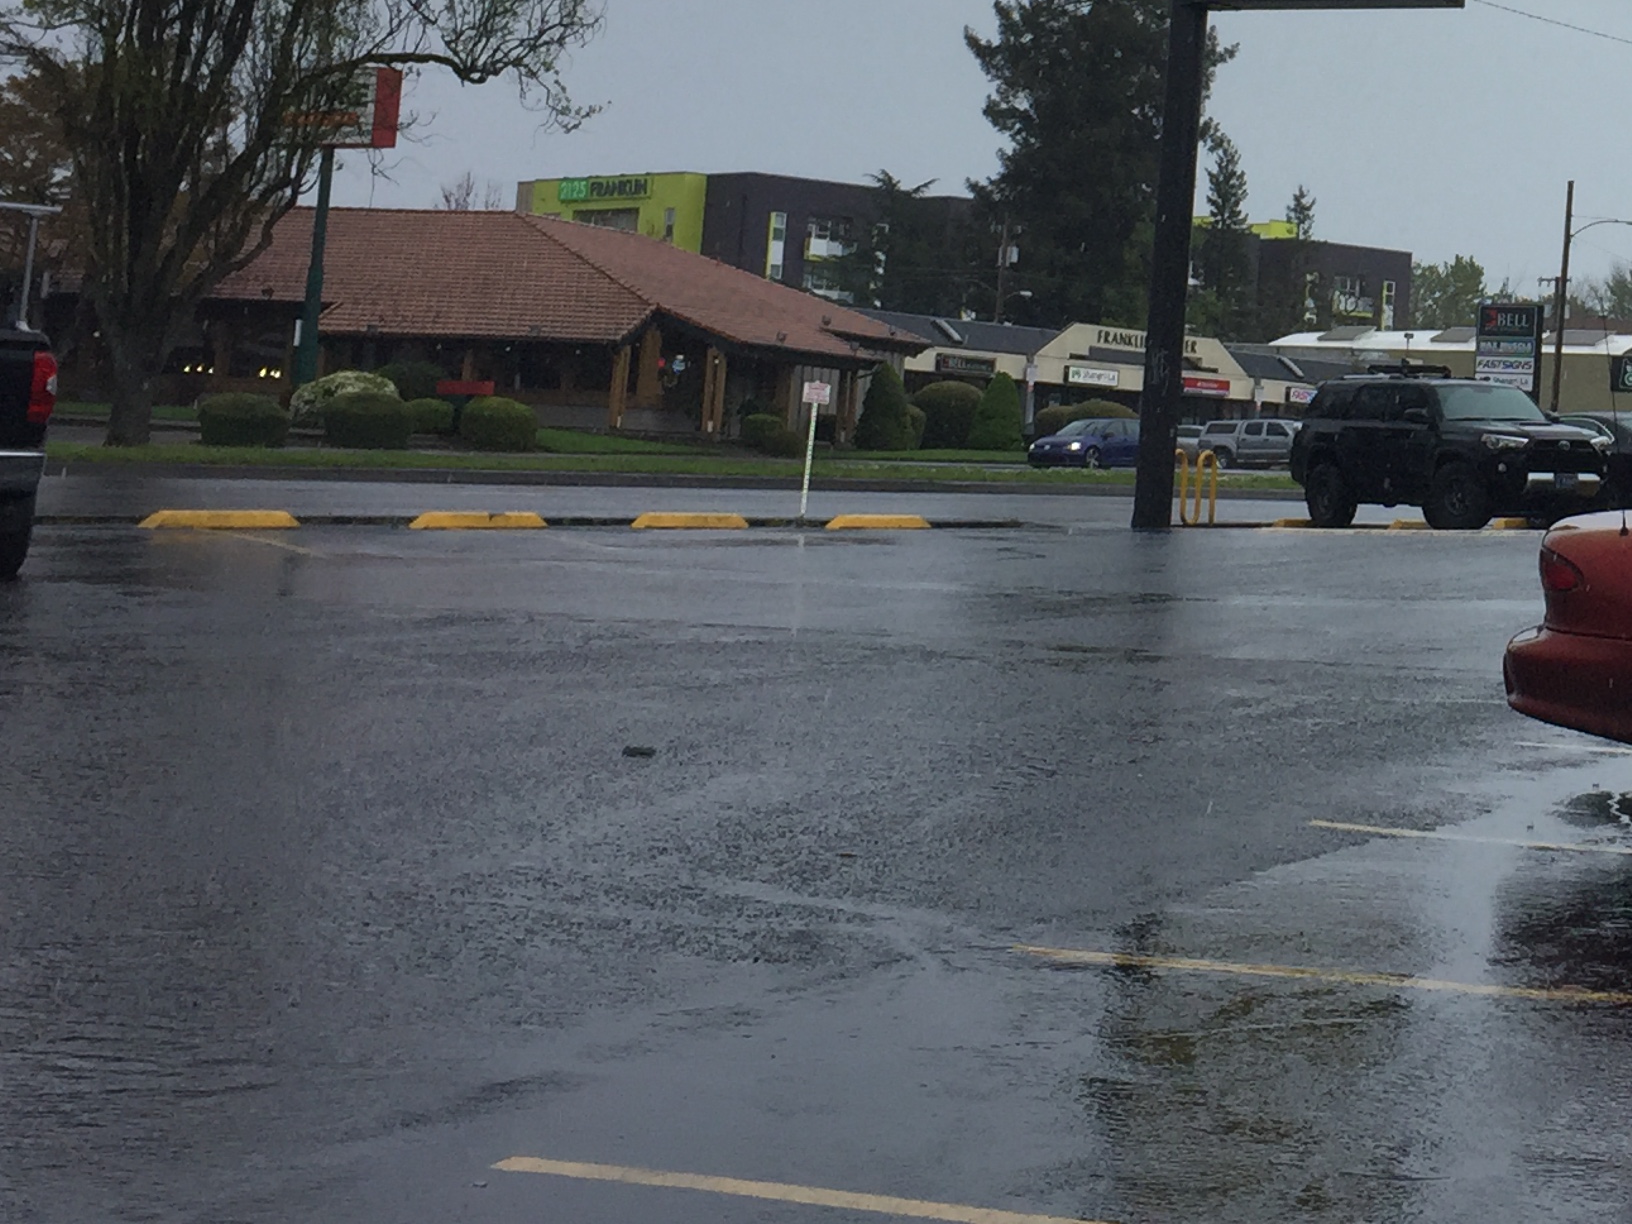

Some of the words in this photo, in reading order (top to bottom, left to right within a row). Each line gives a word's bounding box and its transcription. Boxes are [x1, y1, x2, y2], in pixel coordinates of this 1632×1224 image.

[1497, 312, 1529, 327] BELL
[1096, 329, 1147, 349] FRANKLI
[1477, 359, 1533, 370] FASTSIGNS
